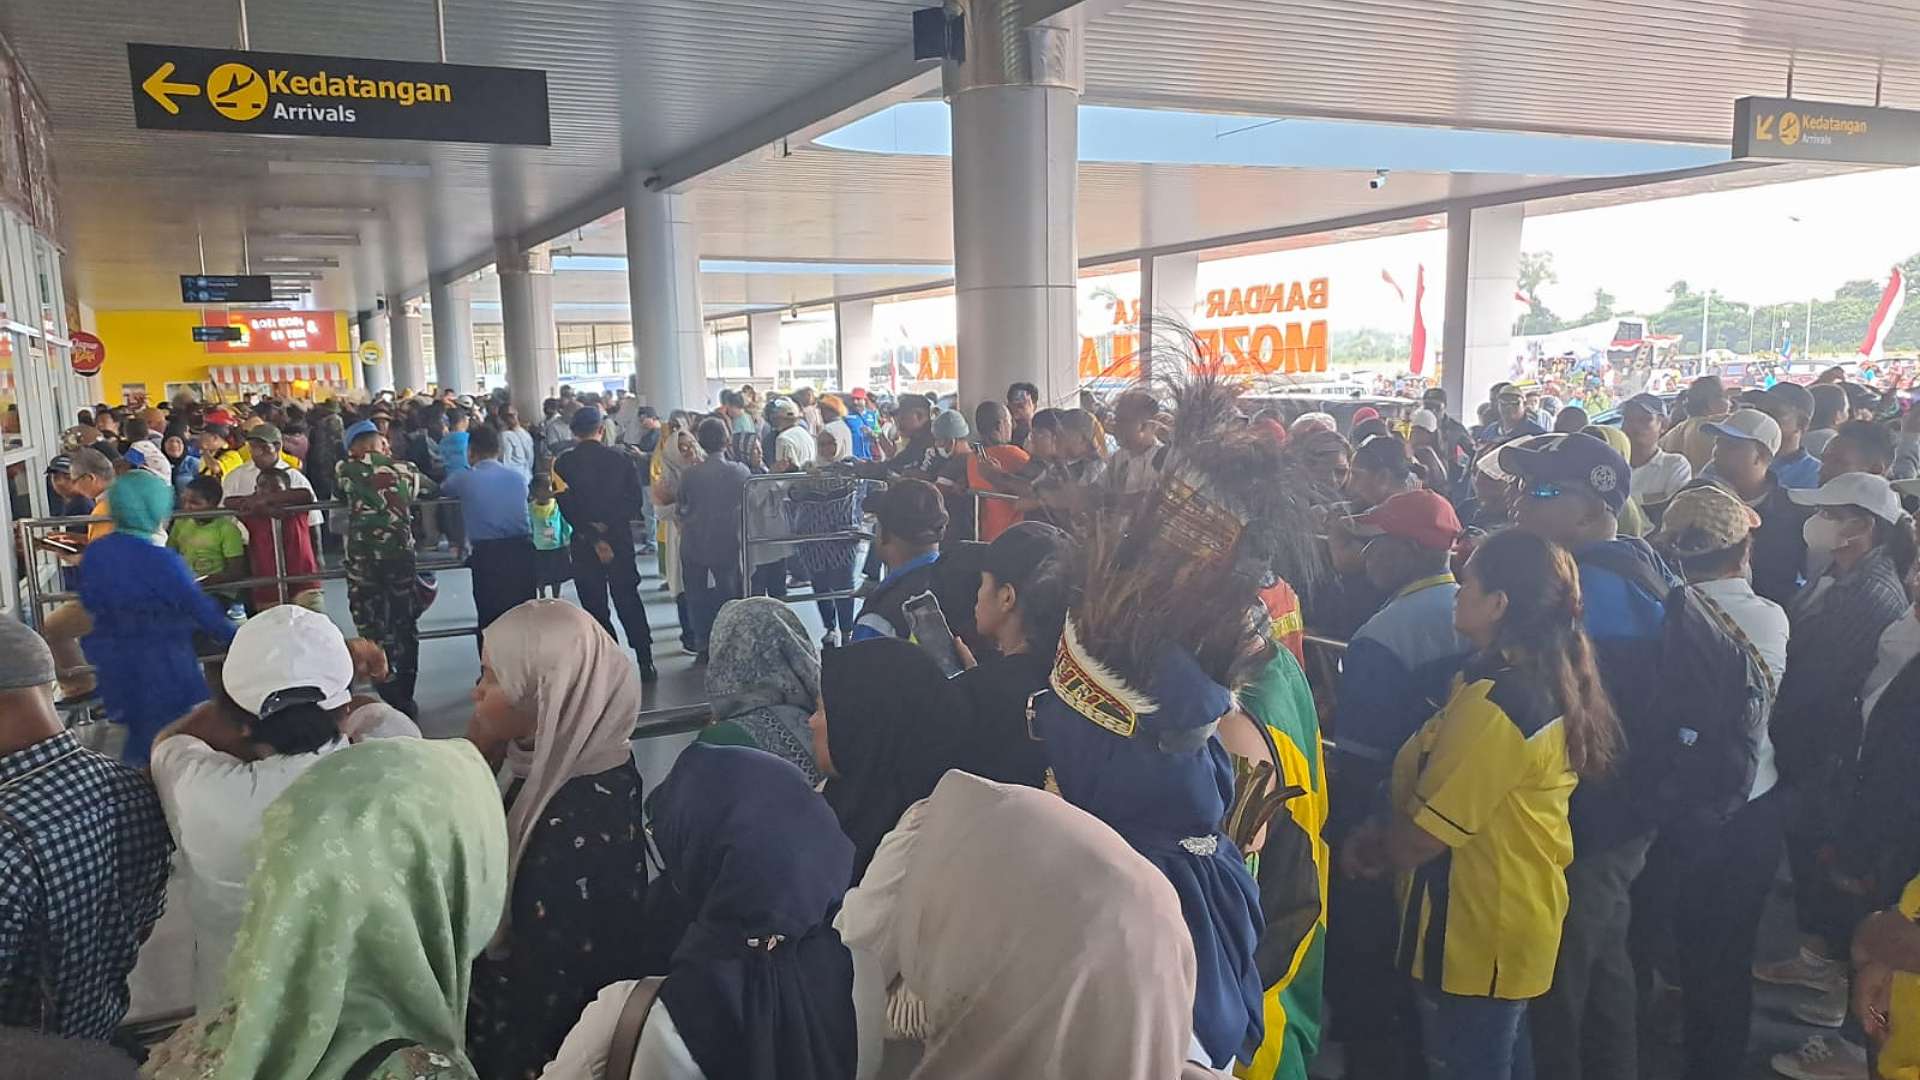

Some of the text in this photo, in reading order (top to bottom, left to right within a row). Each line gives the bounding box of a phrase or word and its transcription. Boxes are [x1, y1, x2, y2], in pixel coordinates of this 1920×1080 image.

[267, 69, 452, 107] Kedatangan
[273, 102, 356, 123] Arrivals
[1802, 113, 1867, 135] Kedatangan
[1802, 133, 1833, 145] Arrivals
